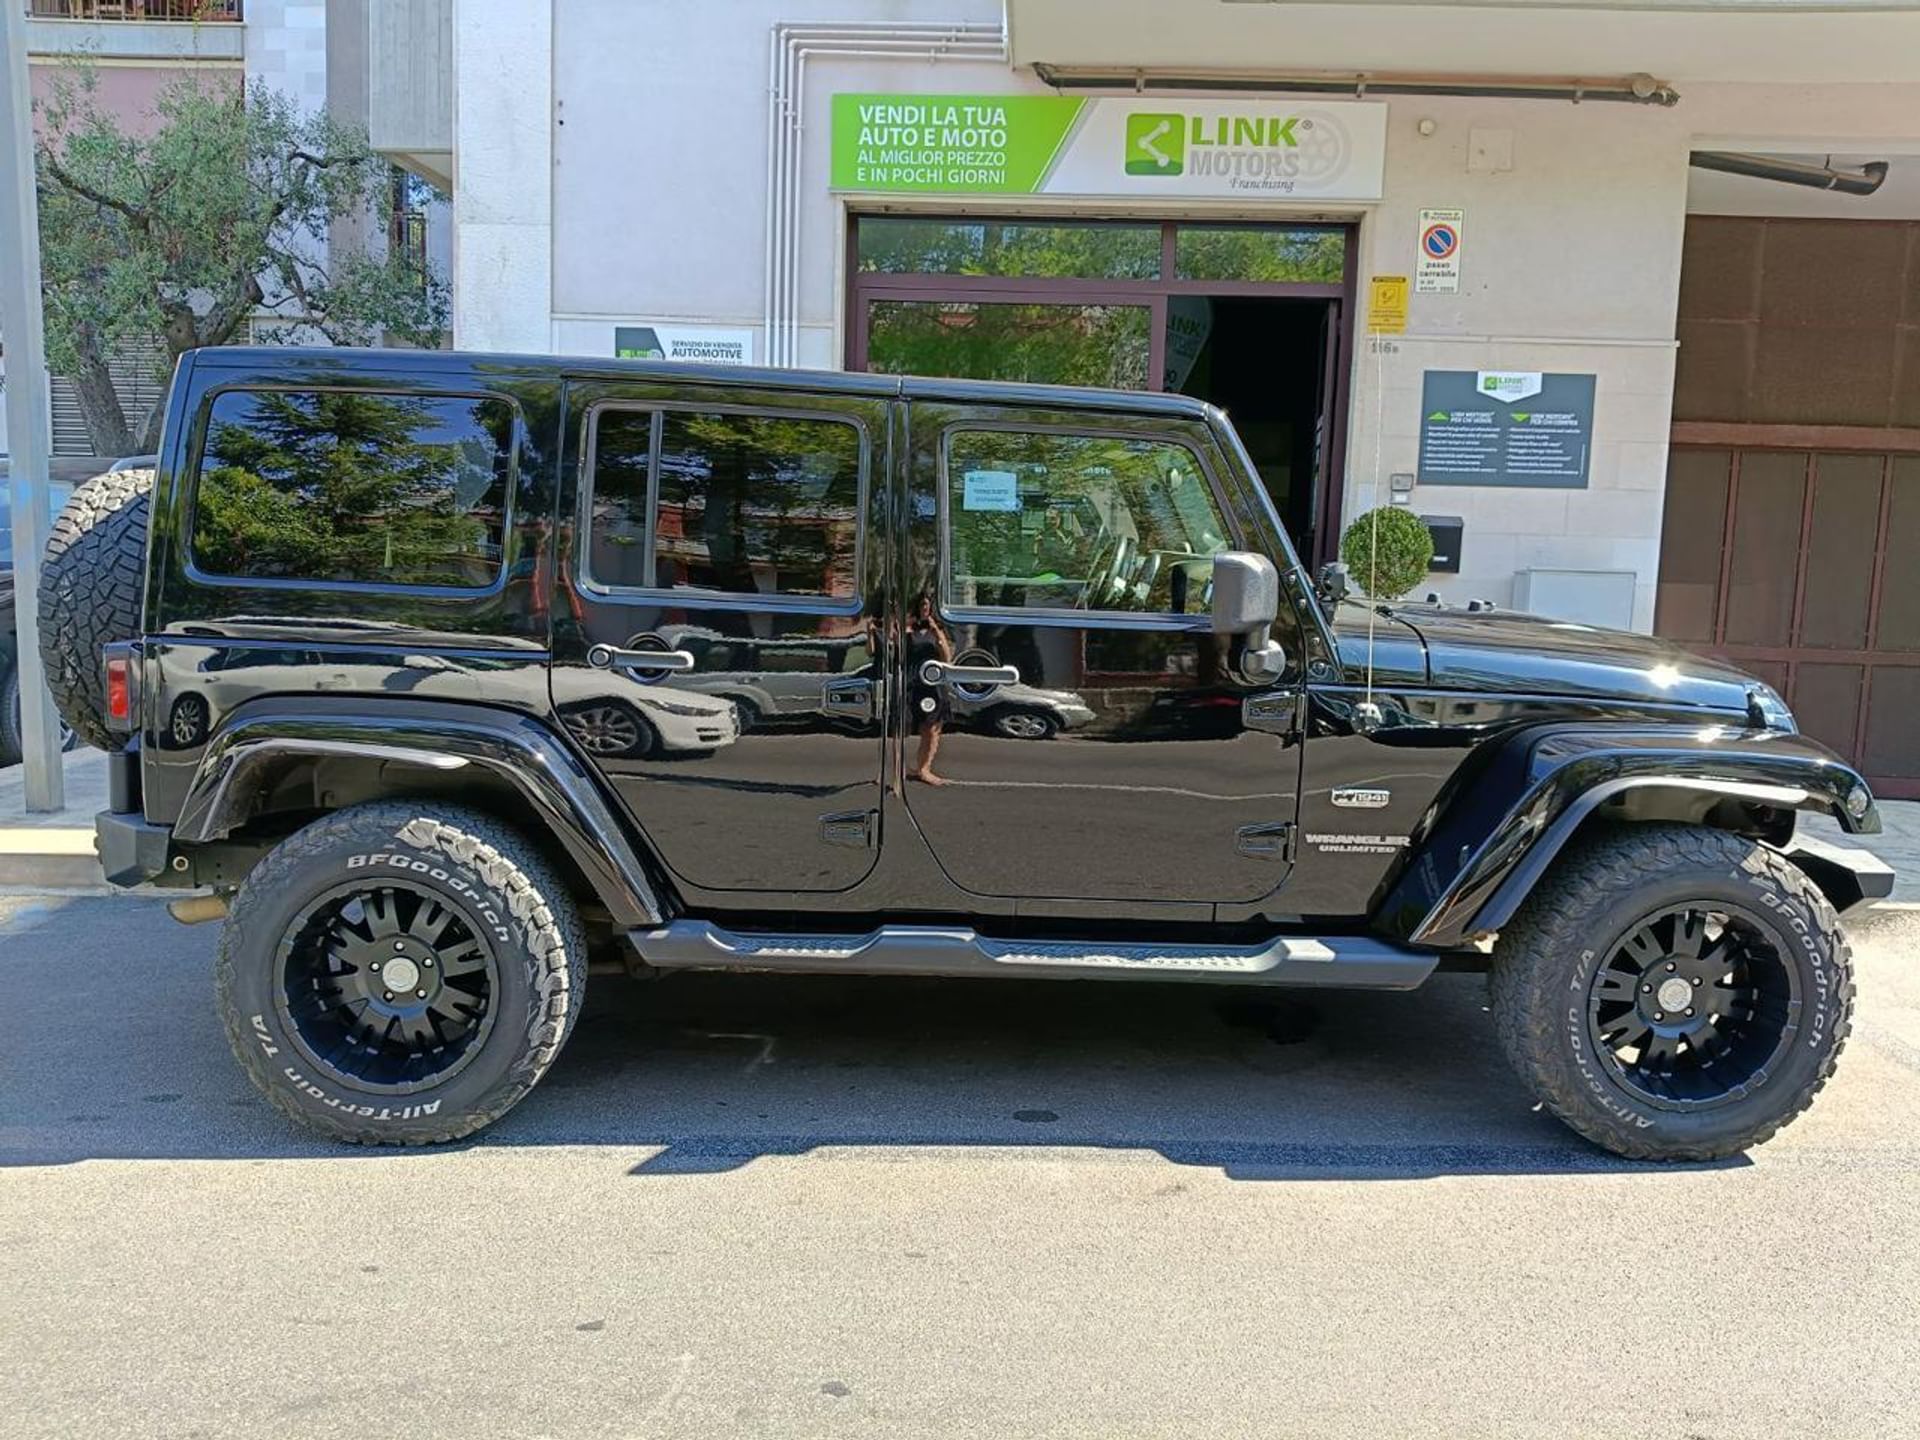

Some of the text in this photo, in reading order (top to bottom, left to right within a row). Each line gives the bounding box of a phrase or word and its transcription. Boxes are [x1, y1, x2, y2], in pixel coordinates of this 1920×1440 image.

[859, 105, 1007, 126] VENDI LA TUA
[858, 127, 1007, 148] AUTO E MOTO
[857, 149, 1006, 166] AL MIGLIOR PREZZO
[1189, 151, 1299, 177] MOTORS
[857, 167, 1005, 184] E IN POCHI GIORNI
[1230, 177, 1295, 192] Franchising
[671, 348, 743, 359] AUTOMOTIVE
[1305, 833, 1411, 847] WRANGLER
[1318, 844, 1397, 854] UNLIMITED
[346, 853, 510, 942] BFGoodrich
[250, 1014, 278, 1058] T/A
[284, 1067, 443, 1121] All-Terrain
